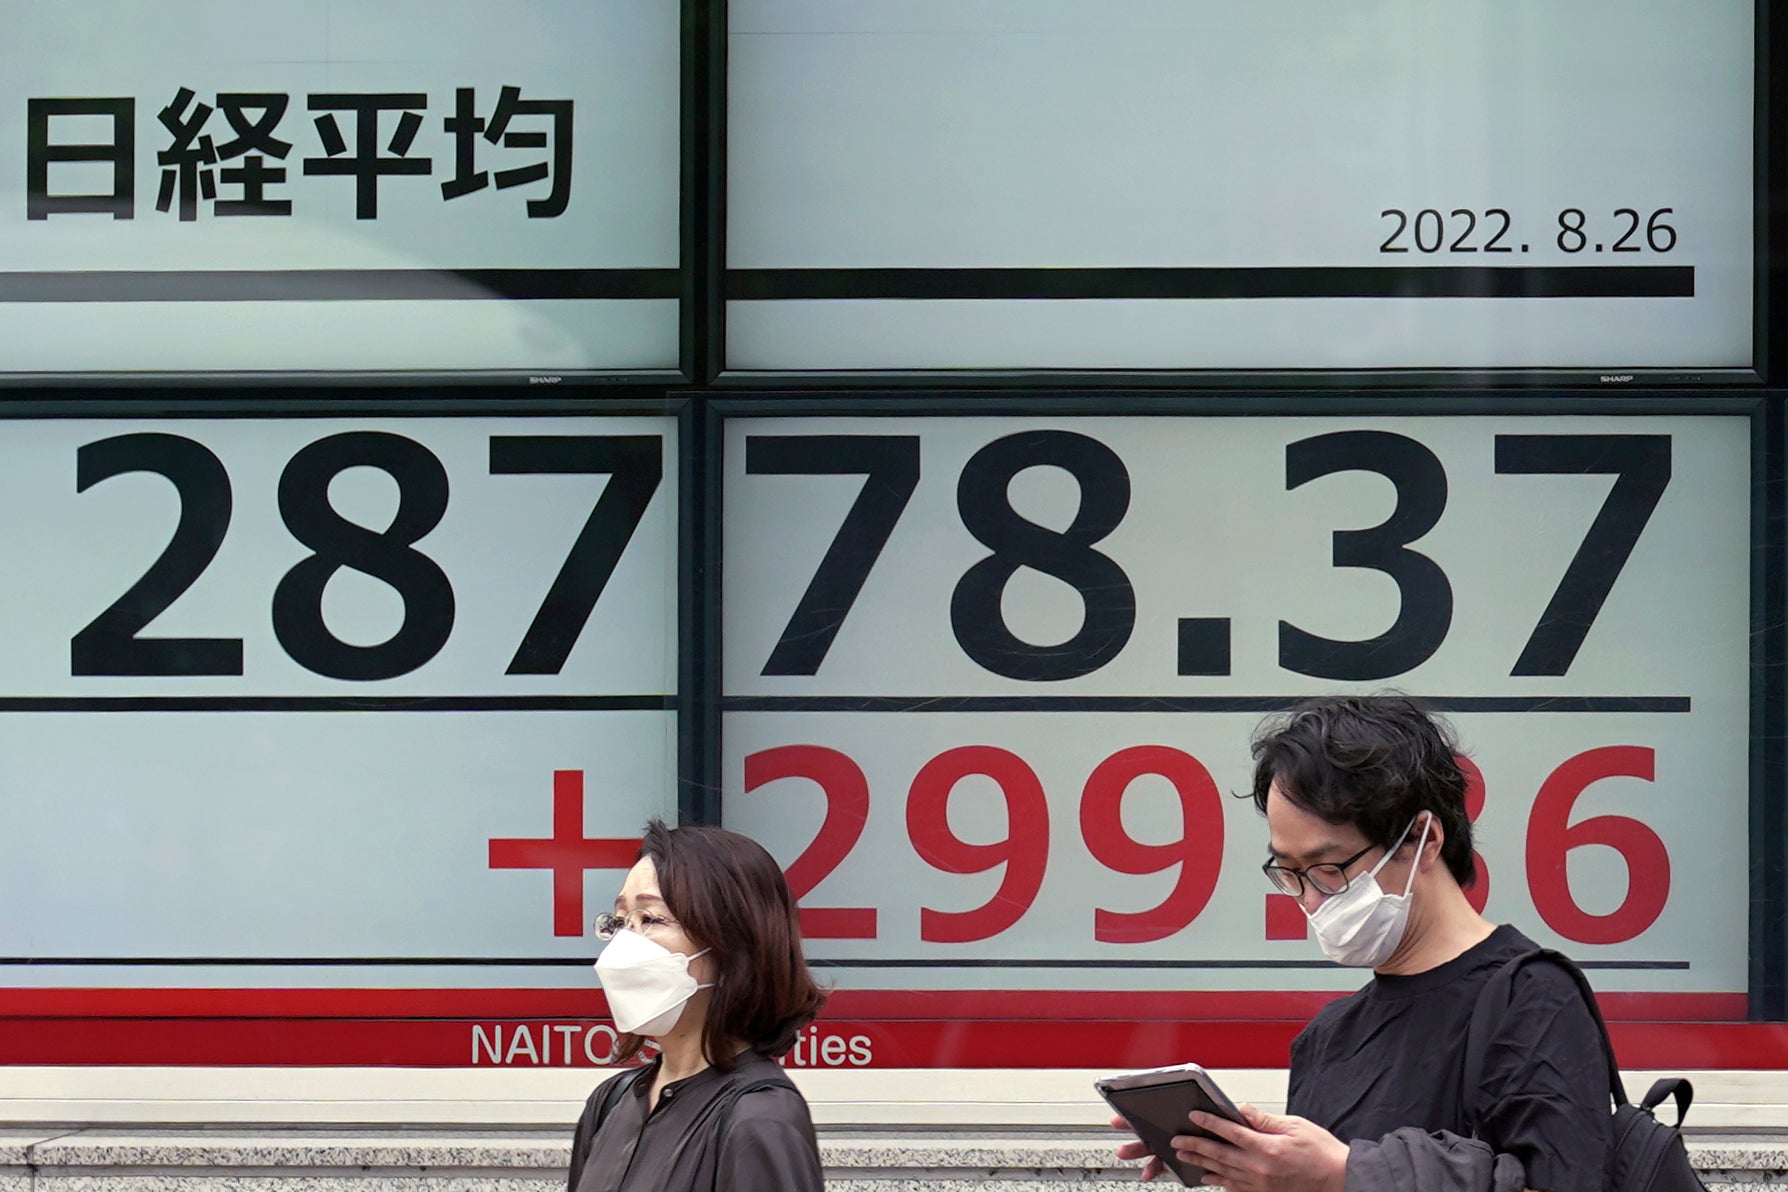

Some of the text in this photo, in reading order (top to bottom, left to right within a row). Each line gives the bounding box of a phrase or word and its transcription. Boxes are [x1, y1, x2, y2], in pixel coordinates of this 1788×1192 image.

[26, 86, 576, 222] 日経平均
[1379, 208, 1678, 253] 2022. 8.26
[70, 430, 1673, 681] 28778.37
